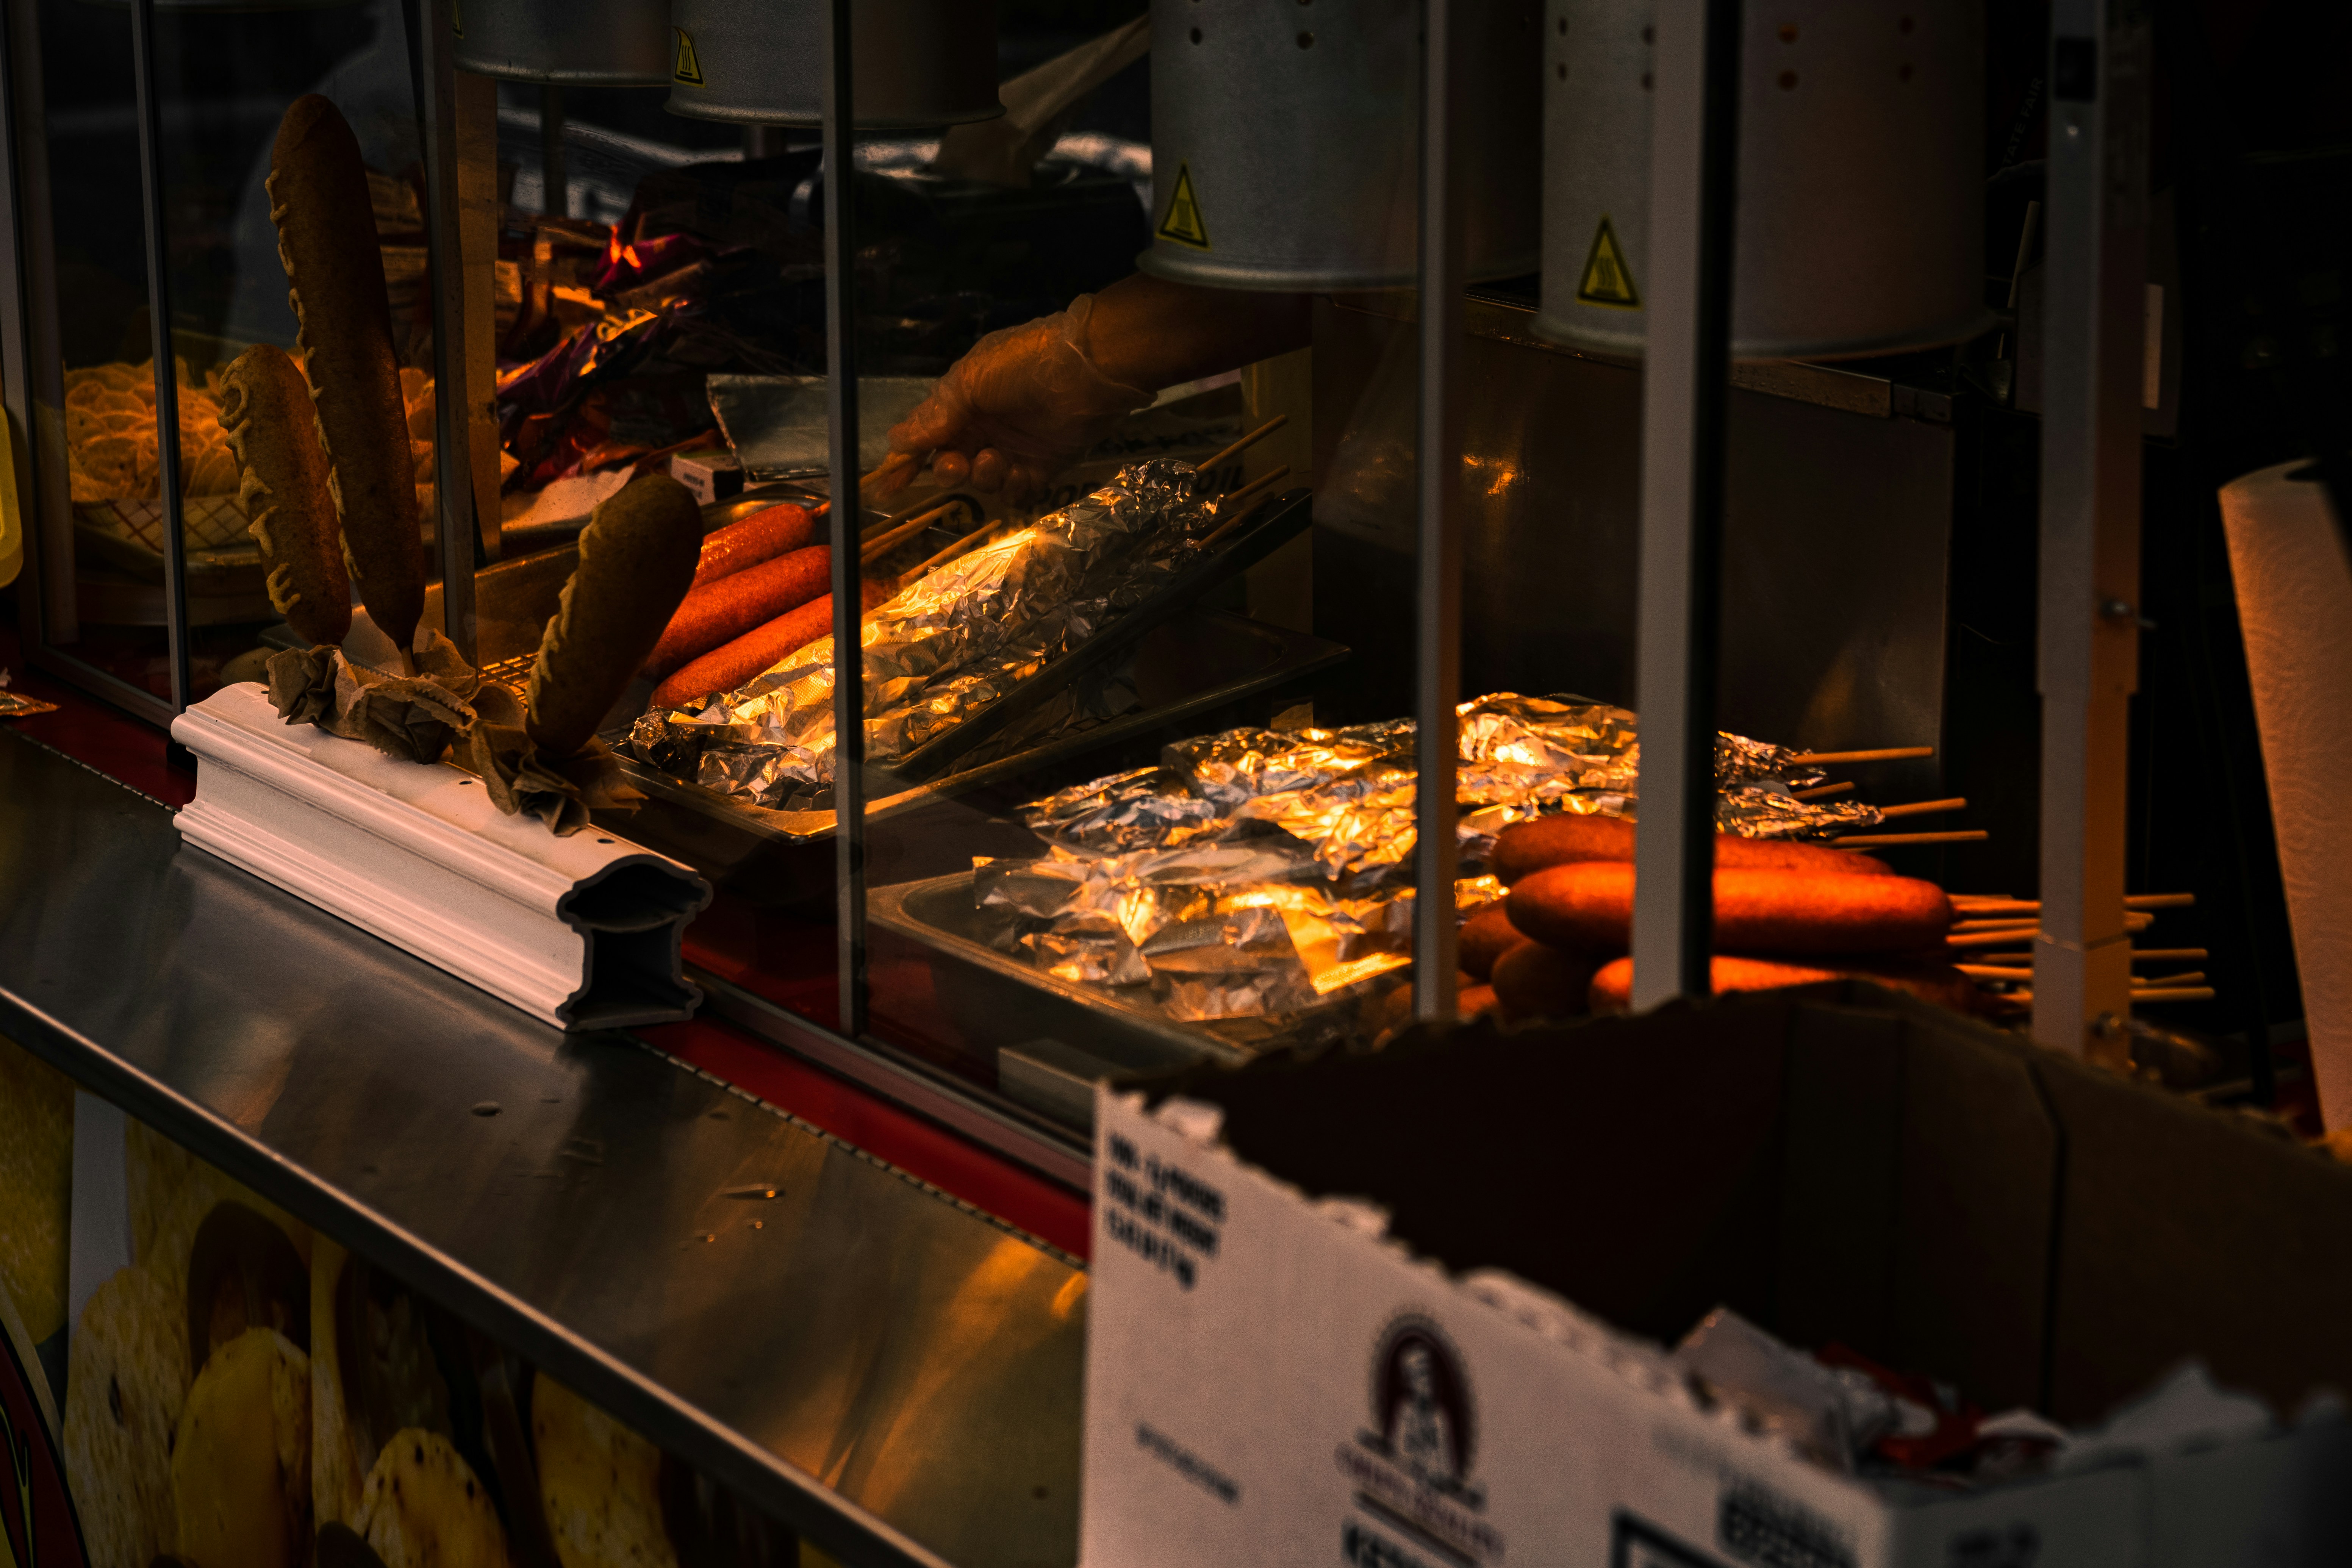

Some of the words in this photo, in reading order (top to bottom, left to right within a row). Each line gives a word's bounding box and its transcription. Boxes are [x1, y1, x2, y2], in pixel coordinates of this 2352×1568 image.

[2002, 122, 2027, 166] TATE
[2020, 77, 2044, 118] FAIR
[1195, 466, 1243, 494] OIL
